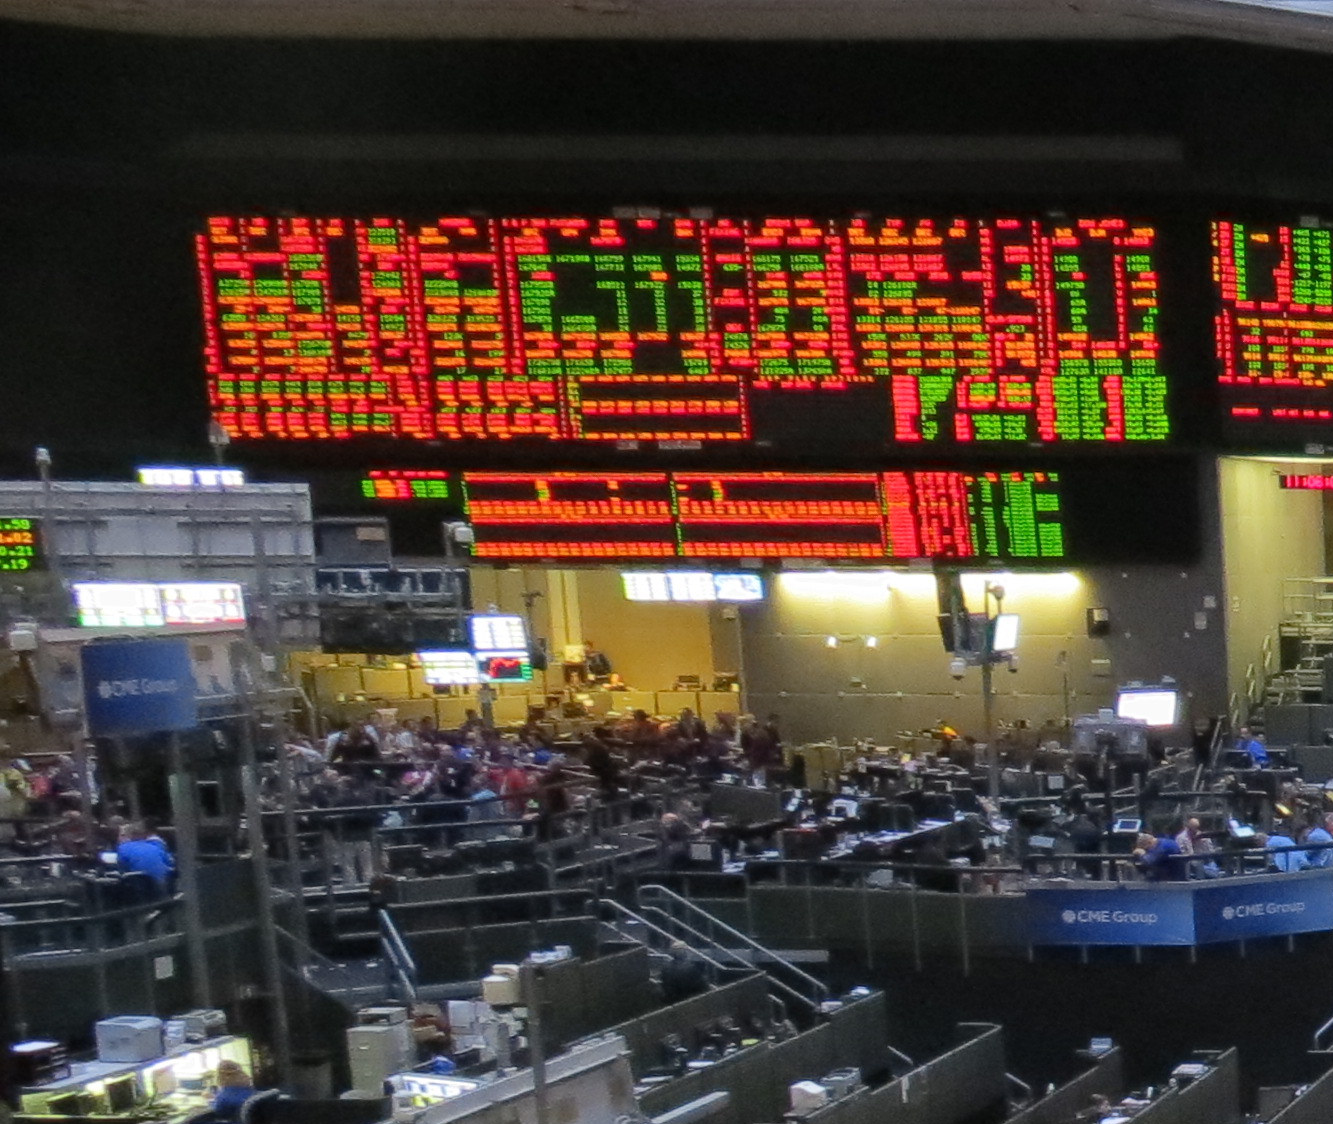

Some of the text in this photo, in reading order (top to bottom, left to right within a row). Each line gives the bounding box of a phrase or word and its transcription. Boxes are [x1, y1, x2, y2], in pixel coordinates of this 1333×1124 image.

[1077, 910, 1158, 925] CME Group
[1235, 902, 1305, 918] CME Group
